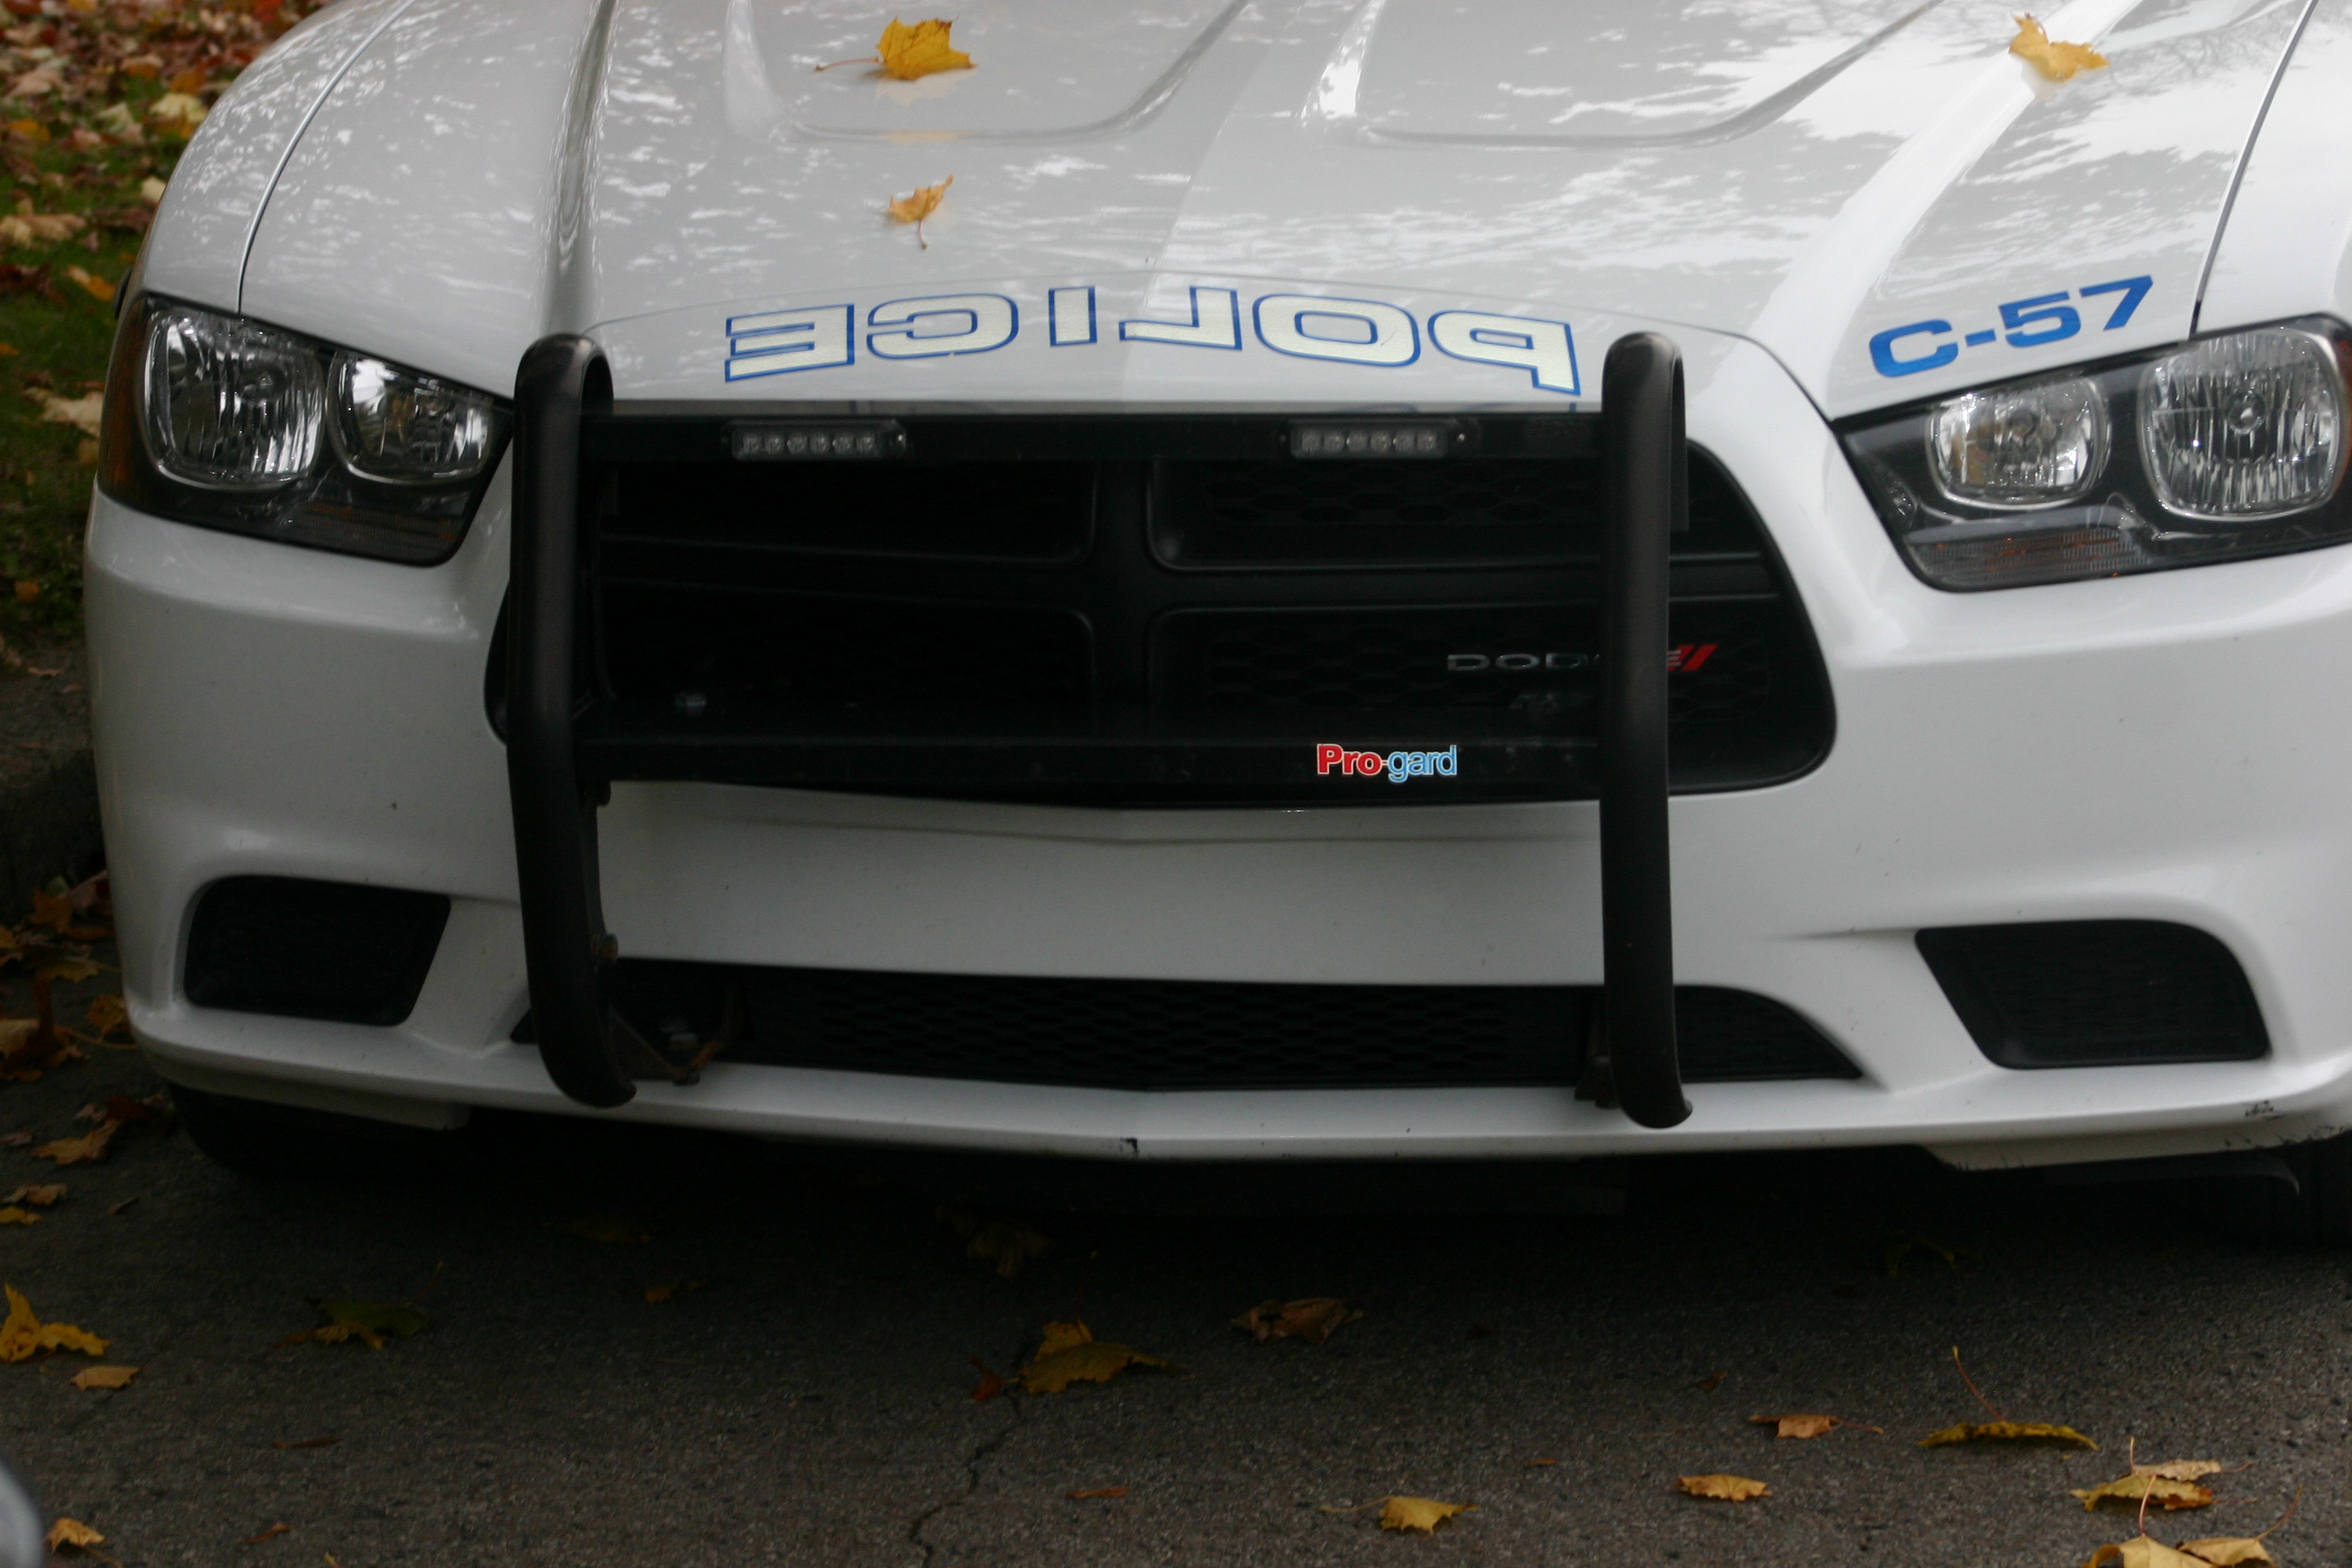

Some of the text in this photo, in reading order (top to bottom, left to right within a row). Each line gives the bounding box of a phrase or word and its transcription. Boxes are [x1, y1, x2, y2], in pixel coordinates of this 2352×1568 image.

[1869, 274, 2153, 377] C-57
[1447, 653, 1683, 671] DOD
[1316, 743, 1457, 782] Pro-gard
